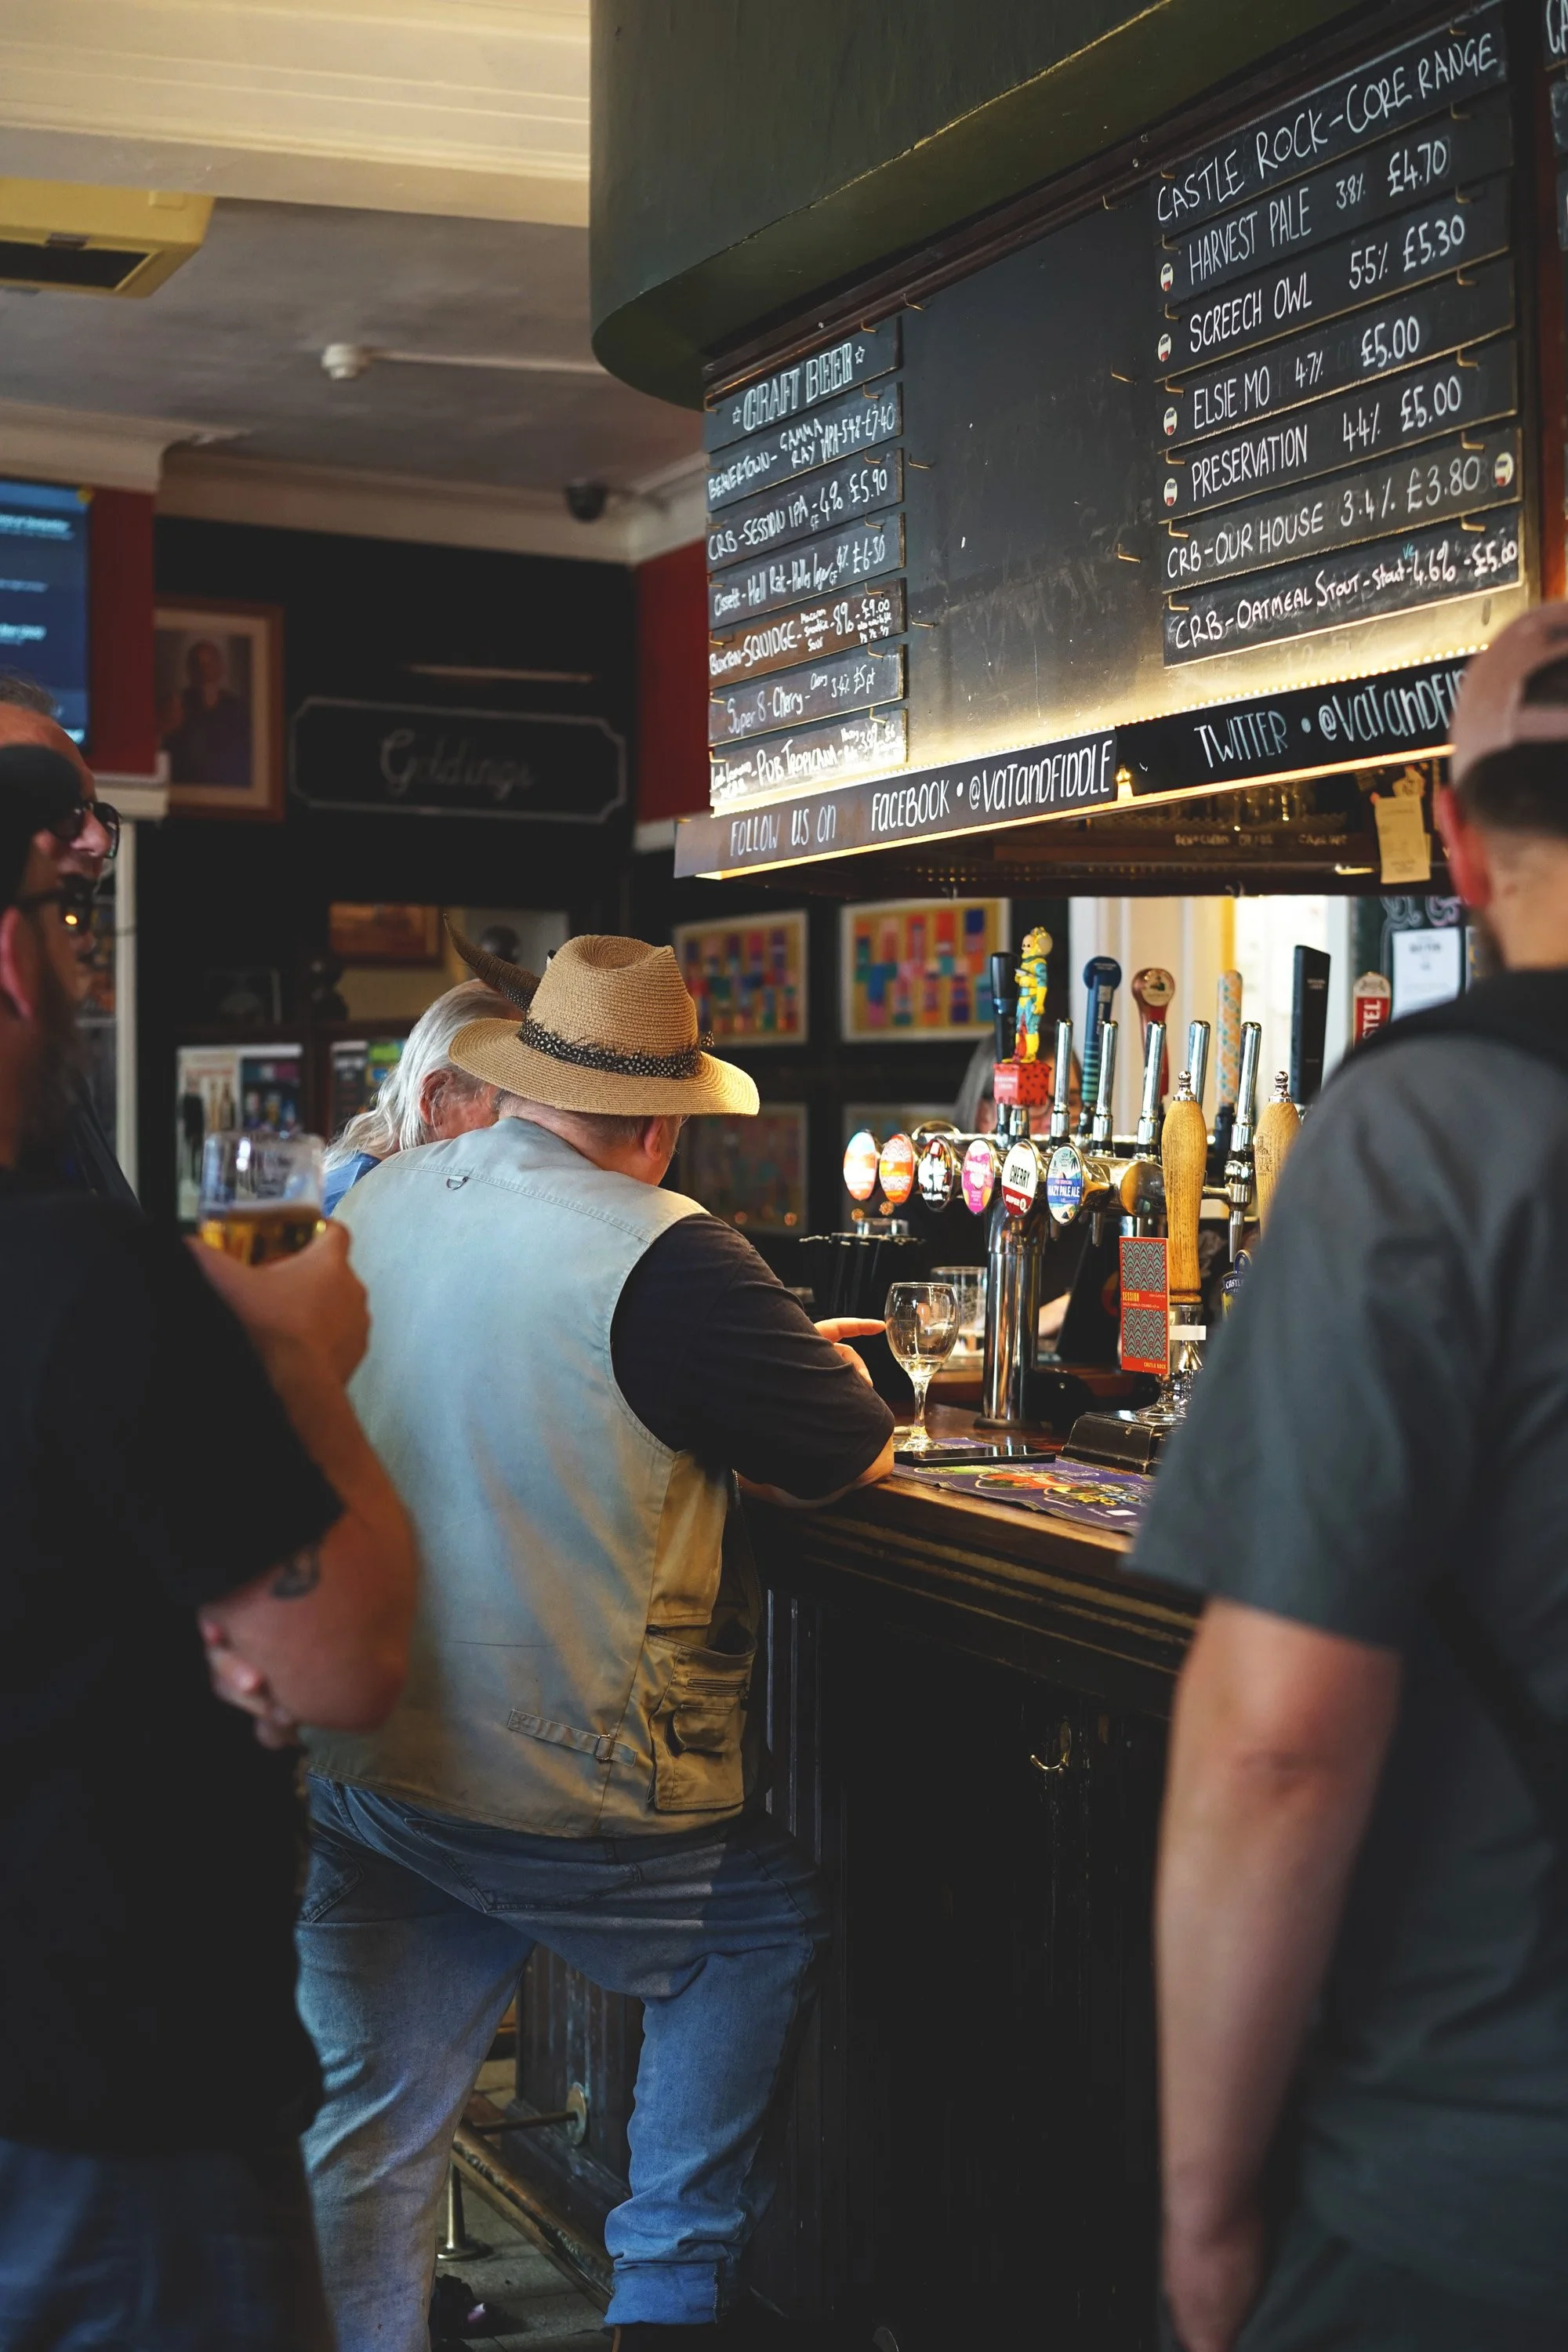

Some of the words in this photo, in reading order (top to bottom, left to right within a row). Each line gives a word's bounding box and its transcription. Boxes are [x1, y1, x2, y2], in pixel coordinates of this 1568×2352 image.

[1157, 150, 1244, 221] CASTLE
[1418, 33, 1497, 99] RANGE
[1189, 211, 1257, 285] HARVEST
[1270, 187, 1311, 247] PALE
[1388, 140, 1446, 197] £4.70
[1190, 289, 1261, 352] SCREECH
[1275, 273, 1312, 319] OWL
[1403, 215, 1465, 272] £5.30
[743, 368, 800, 431] CRAFT
[806, 343, 853, 403] BEER
[1194, 379, 1236, 430] ELSIE
[1245, 365, 1269, 409] MO
[1362, 315, 1420, 368] £5.00
[791, 441, 815, 469] RAY
[1192, 424, 1308, 502] PRESERVATION
[1401, 376, 1461, 431] £5.00
[789, 495, 809, 528] IPA
[849, 469, 887, 504] £5.90
[1260, 502, 1324, 553] HOUSE
[1406, 456, 1480, 514] £3.80
[862, 599, 890, 619] £9.00
[727, 698, 756, 736] Super
[1194, 710, 1288, 768] TWITTER
[757, 750, 784, 786] PUB
[731, 814, 780, 856] FOLLOW
[872, 779, 950, 831] FACEBOOK
[1010, 1164, 1030, 1189] CHERRY
[1060, 1185, 1071, 1197] PALE
[1071, 1186, 1080, 1197] ALE
